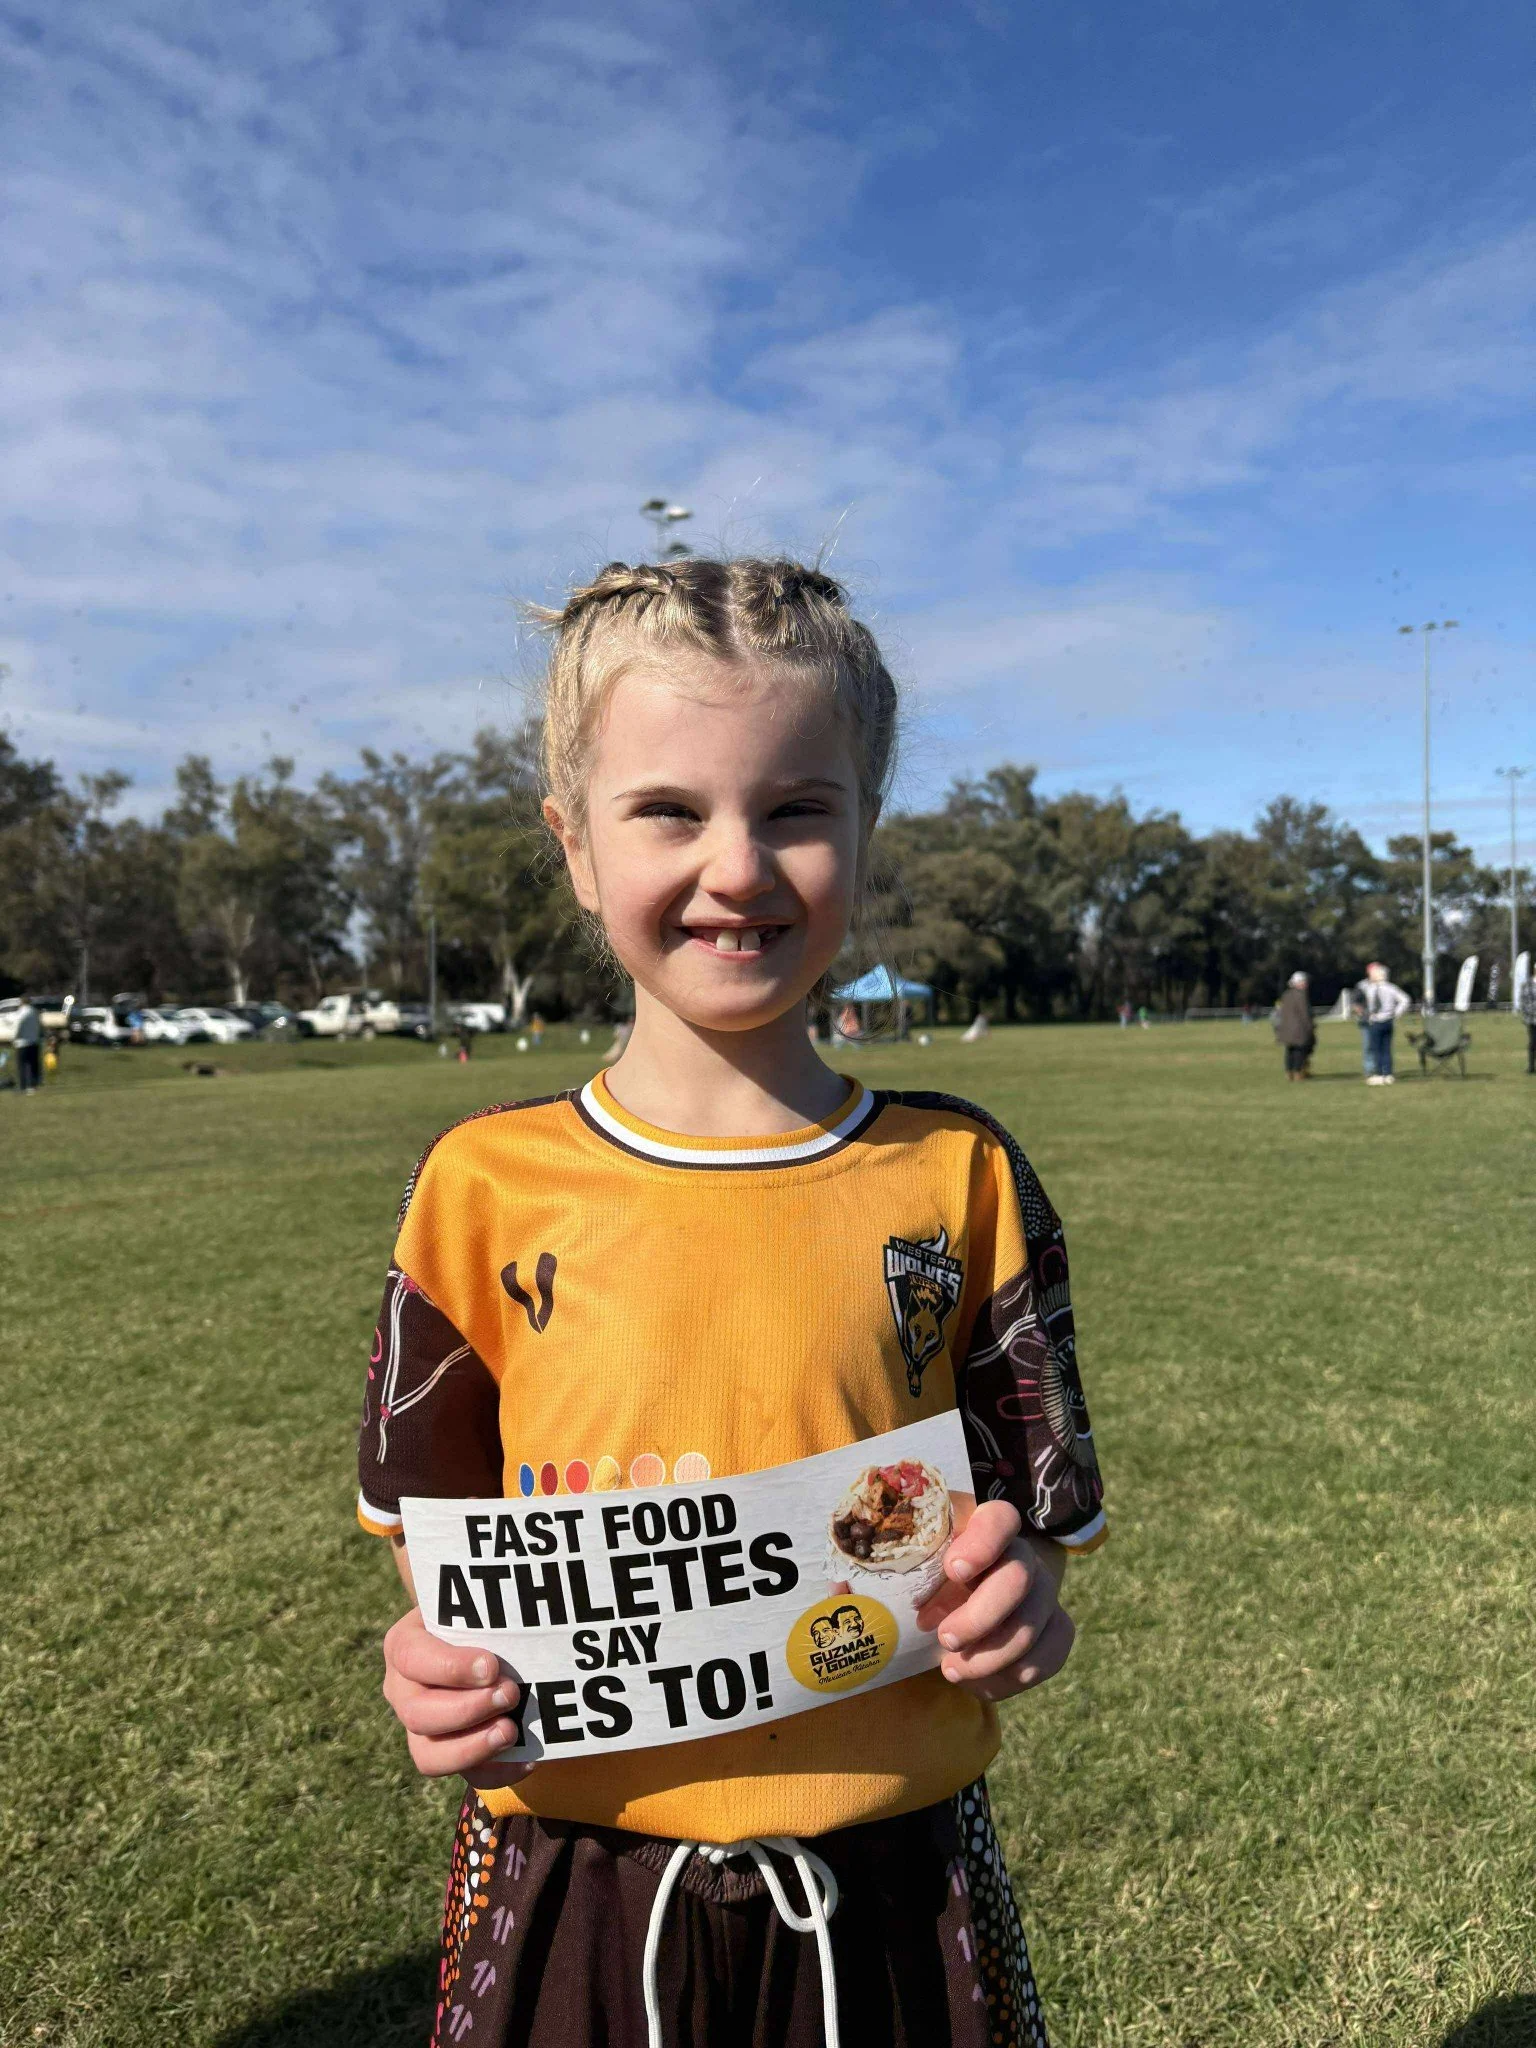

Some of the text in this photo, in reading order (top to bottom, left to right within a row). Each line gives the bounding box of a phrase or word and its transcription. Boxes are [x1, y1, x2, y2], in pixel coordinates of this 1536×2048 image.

[886, 1249, 961, 1303] WOLVES
[895, 1240, 957, 1270] WESTERN
[465, 1494, 737, 1558] FAST FOOD
[437, 1532, 799, 1629] ATHLETES
[573, 1623, 661, 1670] SAY
[809, 1634, 875, 1666] GUZMAN
[648, 1651, 774, 1728] TO!
[813, 1665, 823, 1677] Y
[818, 1668, 852, 1686] Mexican
